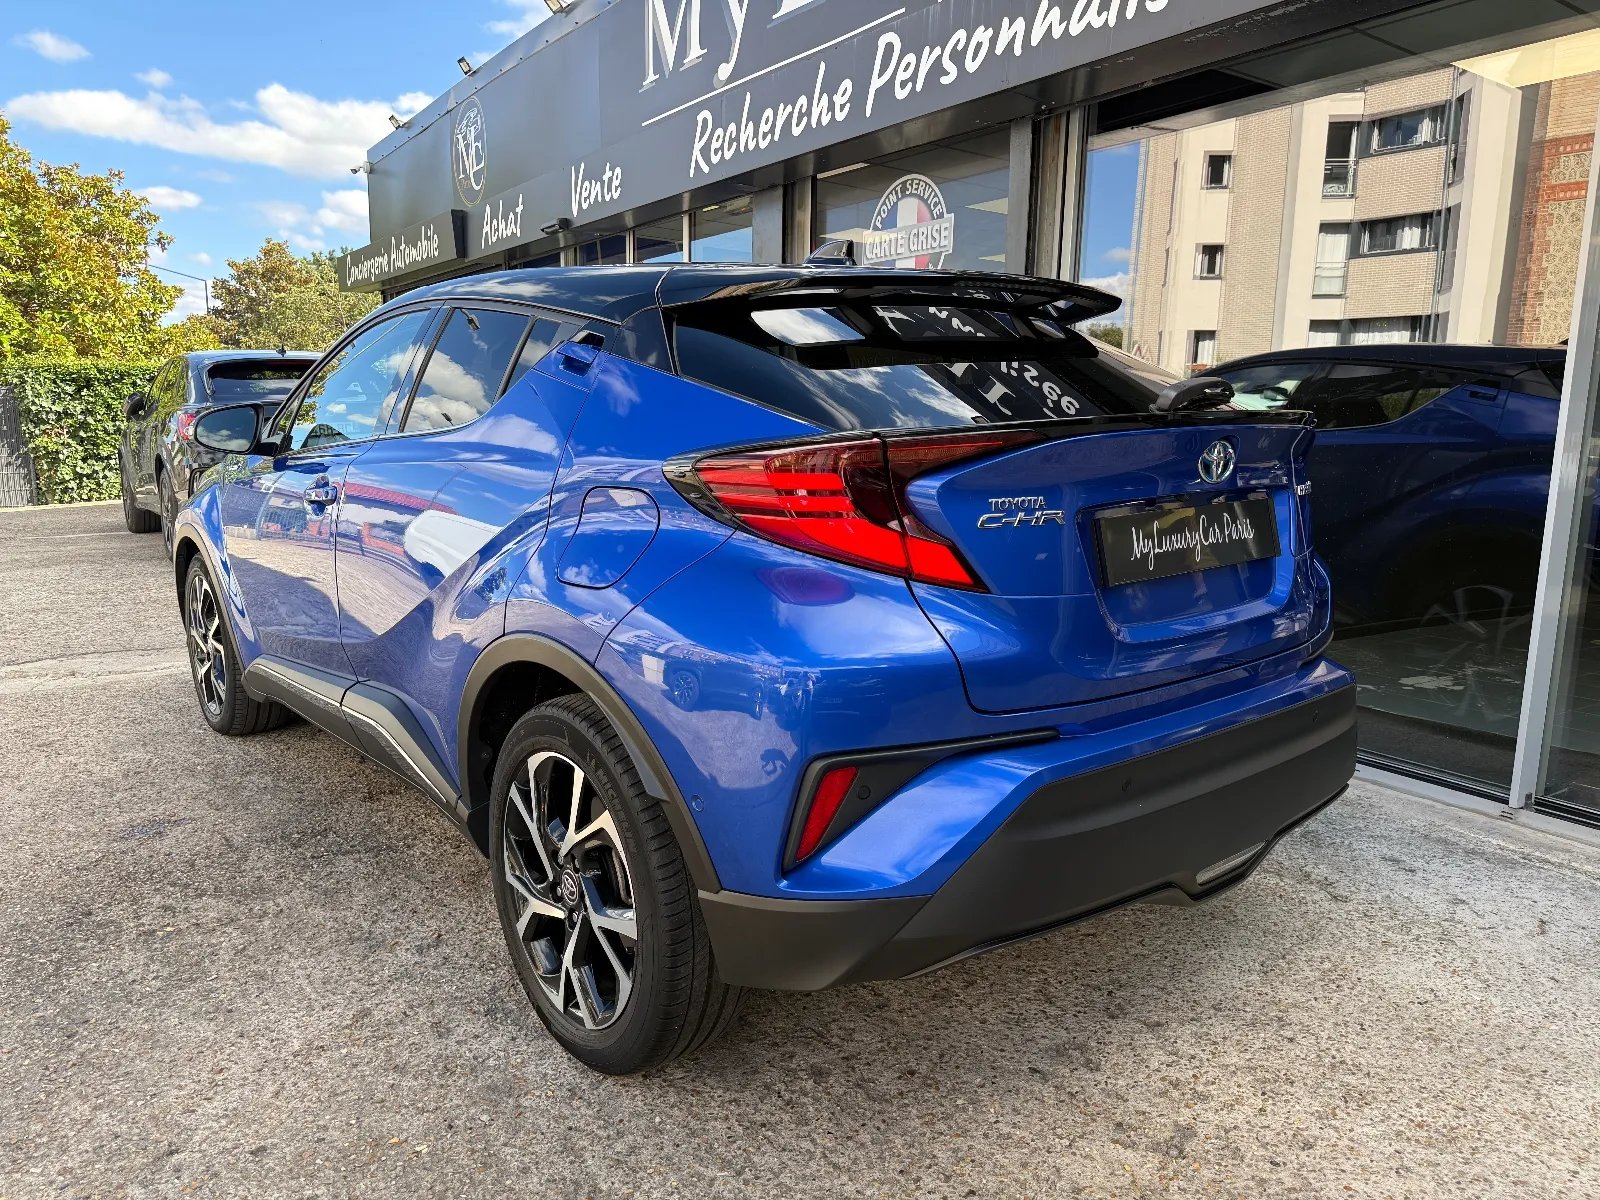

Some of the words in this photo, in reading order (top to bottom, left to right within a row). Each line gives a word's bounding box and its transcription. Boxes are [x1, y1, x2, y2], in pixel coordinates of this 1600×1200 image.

[690, 61, 853, 178] Recherche
[571, 161, 622, 218] Vente
[875, 184, 903, 230] POINT
[905, 179, 943, 220] SERVICE
[481, 193, 524, 249] Achat
[864, 230, 906, 260] CARTE
[909, 221, 950, 252] GRISE
[346, 247, 389, 287] Conciergerie
[390, 223, 439, 273] Automobile
[977, 510, 1066, 529] C-HR
[988, 496, 1047, 512] TOYOTA
[1223, 512, 1255, 544] Paris
